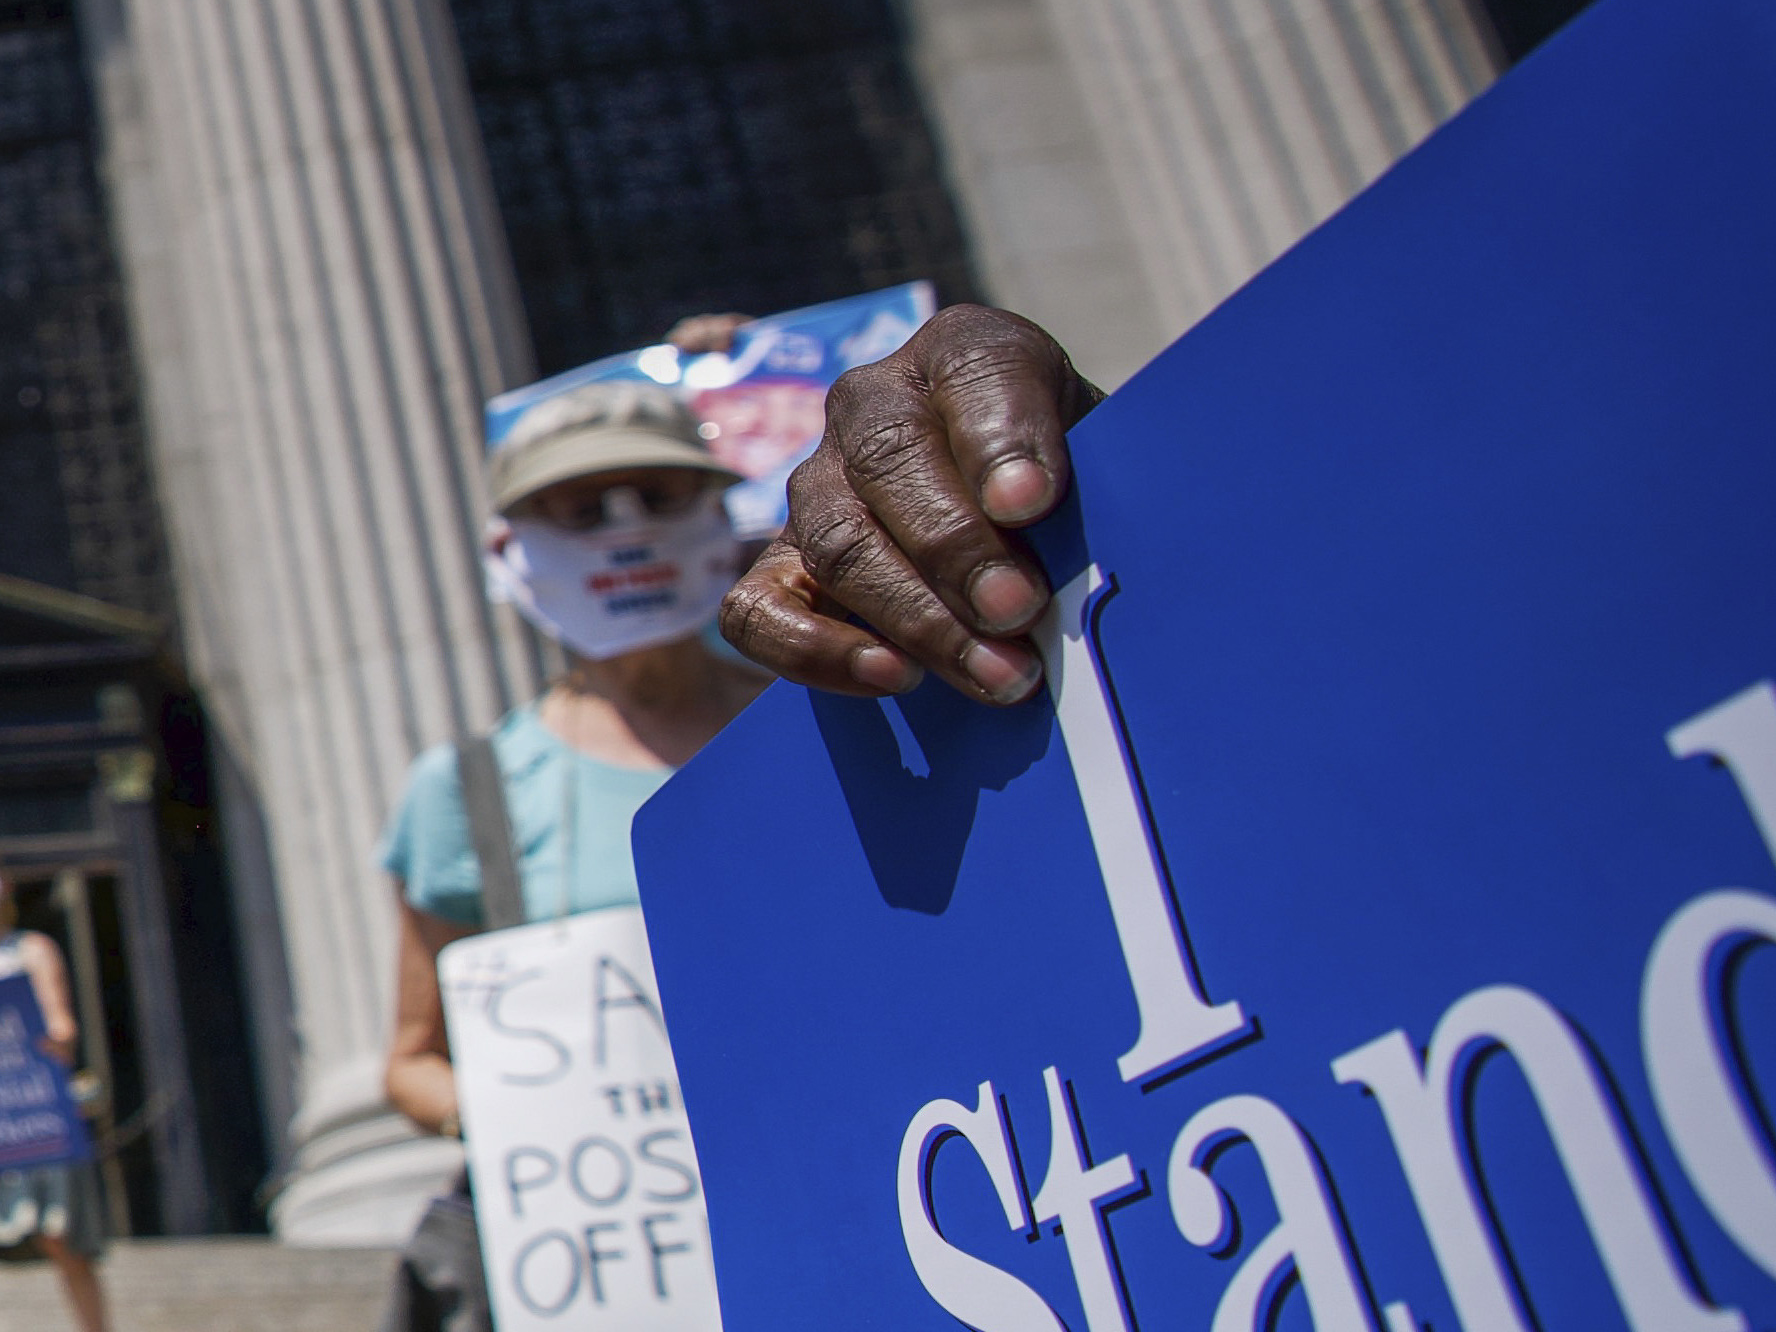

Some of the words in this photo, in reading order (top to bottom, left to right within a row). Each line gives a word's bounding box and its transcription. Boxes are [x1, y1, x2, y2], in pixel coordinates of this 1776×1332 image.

[1036, 562, 1246, 1084] I
[600, 1080, 684, 1115] TH
[503, 1130, 698, 1220] POS
[511, 1211, 706, 1320] OFF
